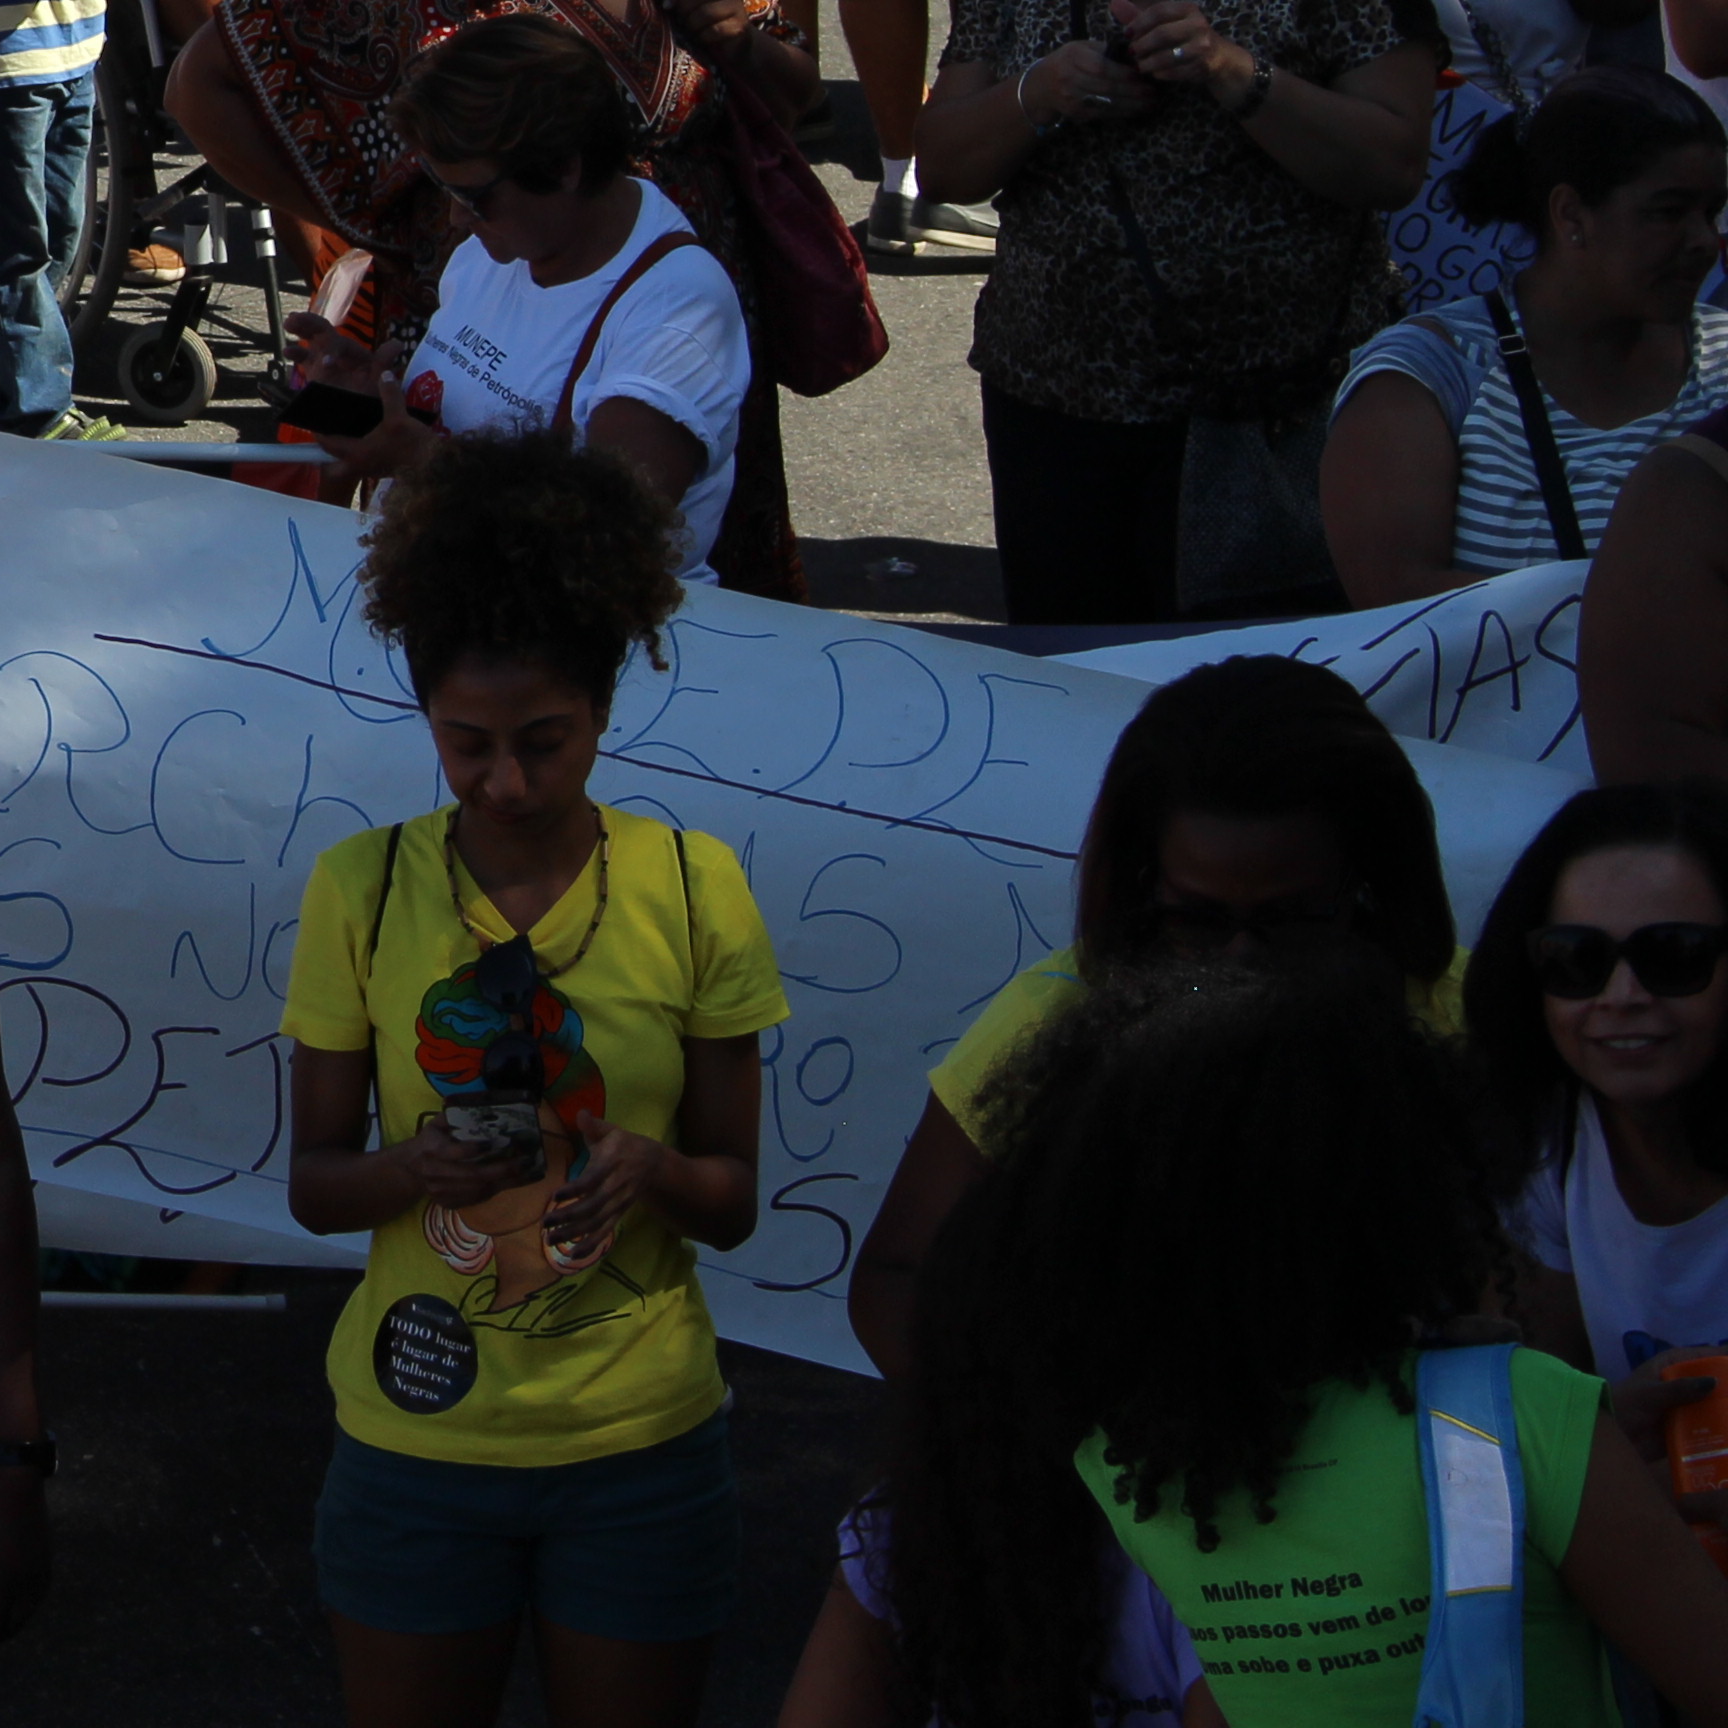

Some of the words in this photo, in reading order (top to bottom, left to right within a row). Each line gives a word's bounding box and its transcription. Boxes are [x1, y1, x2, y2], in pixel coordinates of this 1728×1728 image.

[455, 325, 509, 372] MUNEPE
[388, 1314, 433, 1341] TODO
[435, 1331, 472, 1354] lugar
[391, 1355, 453, 1386] Mulheres
[401, 1339, 438, 1362] lugar
[442, 1353, 460, 1368] de
[393, 1374, 441, 1401] Negras
[1201, 1580, 1284, 1604] Mulher
[1291, 1570, 1364, 1599] Negra
[1224, 1621, 1303, 1644] passos
[1307, 1616, 1361, 1638] vem
[1365, 1605, 1396, 1627] de
[1238, 1657, 1290, 1674] sobe
[1296, 1658, 1312, 1673] e
[1318, 1648, 1381, 1675] puxa
[1385, 1633, 1425, 1659] out
